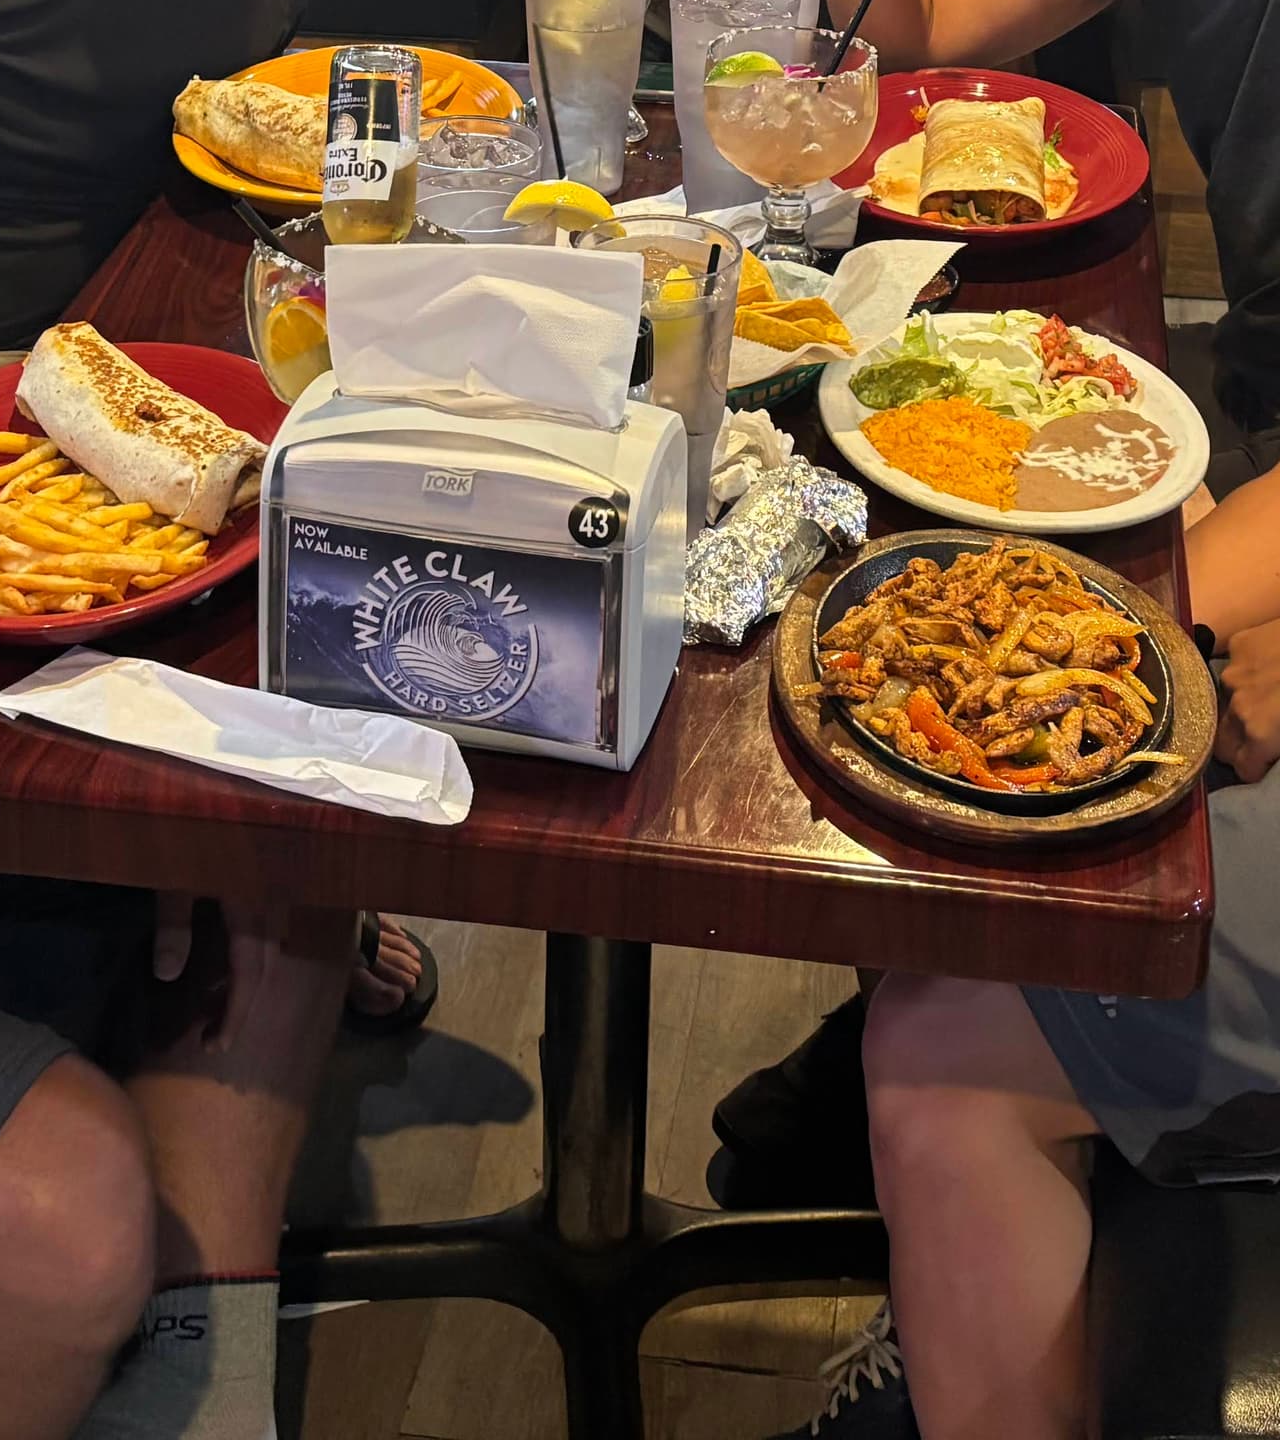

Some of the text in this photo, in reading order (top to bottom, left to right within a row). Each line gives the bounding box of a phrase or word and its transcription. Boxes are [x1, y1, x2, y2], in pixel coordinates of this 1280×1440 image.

[328, 147, 358, 162] Extra
[425, 474, 470, 493] TORK
[293, 522, 329, 540] NOW
[578, 508, 610, 539] 43
[293, 538, 369, 561] AVAILABLE
[352, 550, 529, 651] WHITE CLAW
[382, 637, 528, 713] HARD SELTZER
